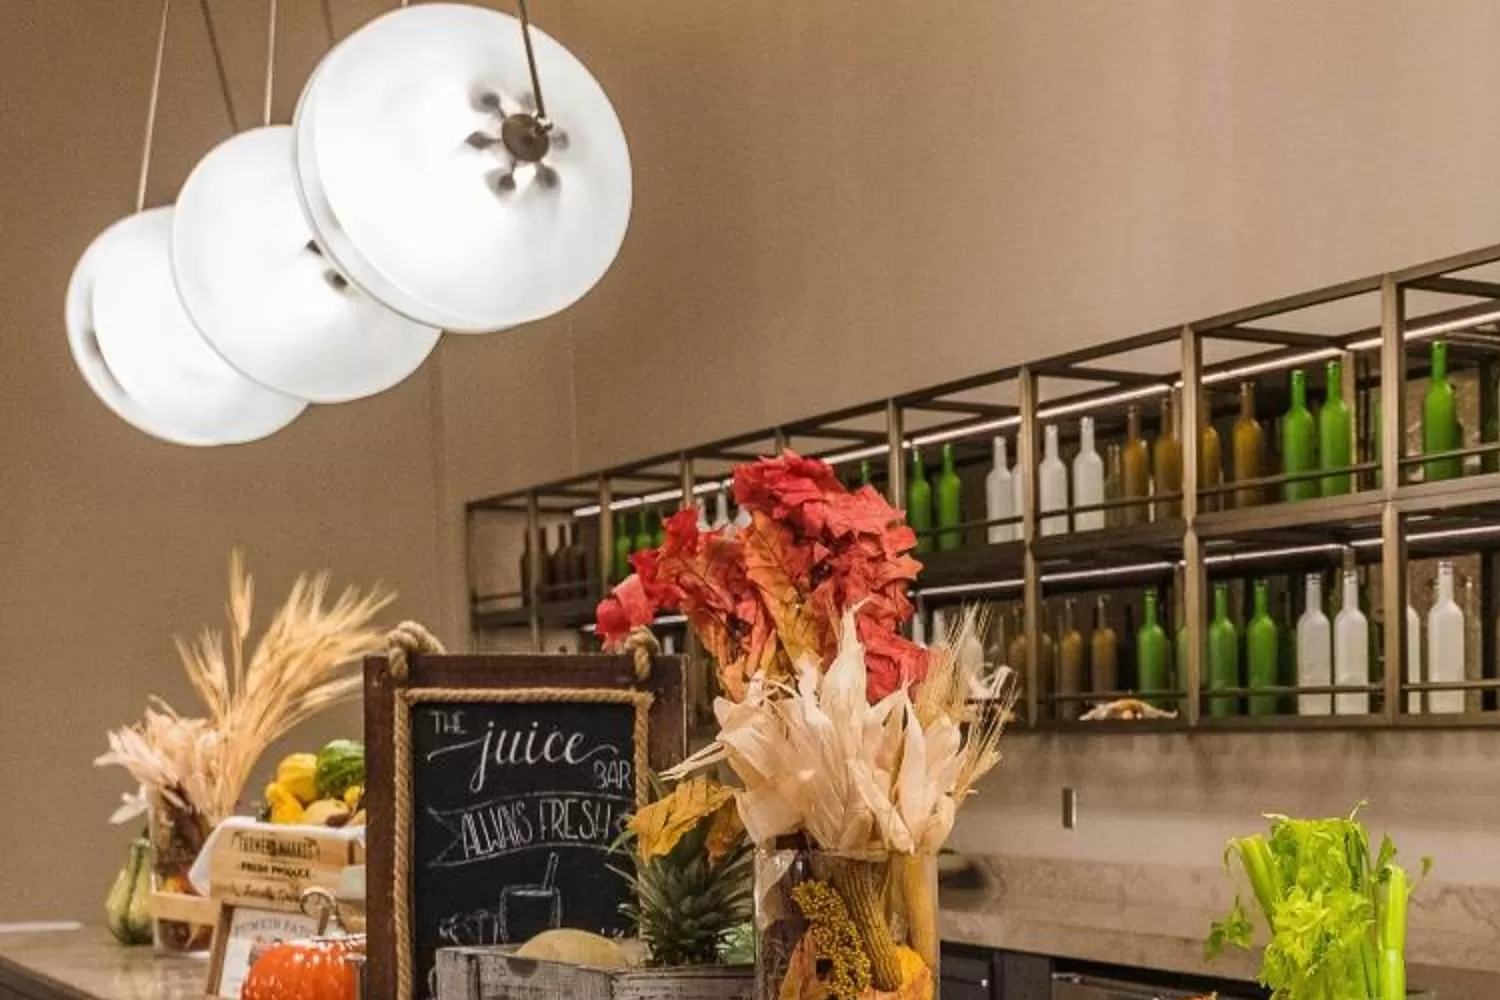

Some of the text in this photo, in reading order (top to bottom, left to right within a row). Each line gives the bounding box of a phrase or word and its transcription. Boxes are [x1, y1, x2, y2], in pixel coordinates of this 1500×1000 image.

[430, 710, 468, 735] THE
[427, 720, 619, 793] juice
[592, 759, 631, 790] BAR
[461, 798, 611, 859] ALWAYS FRESH
